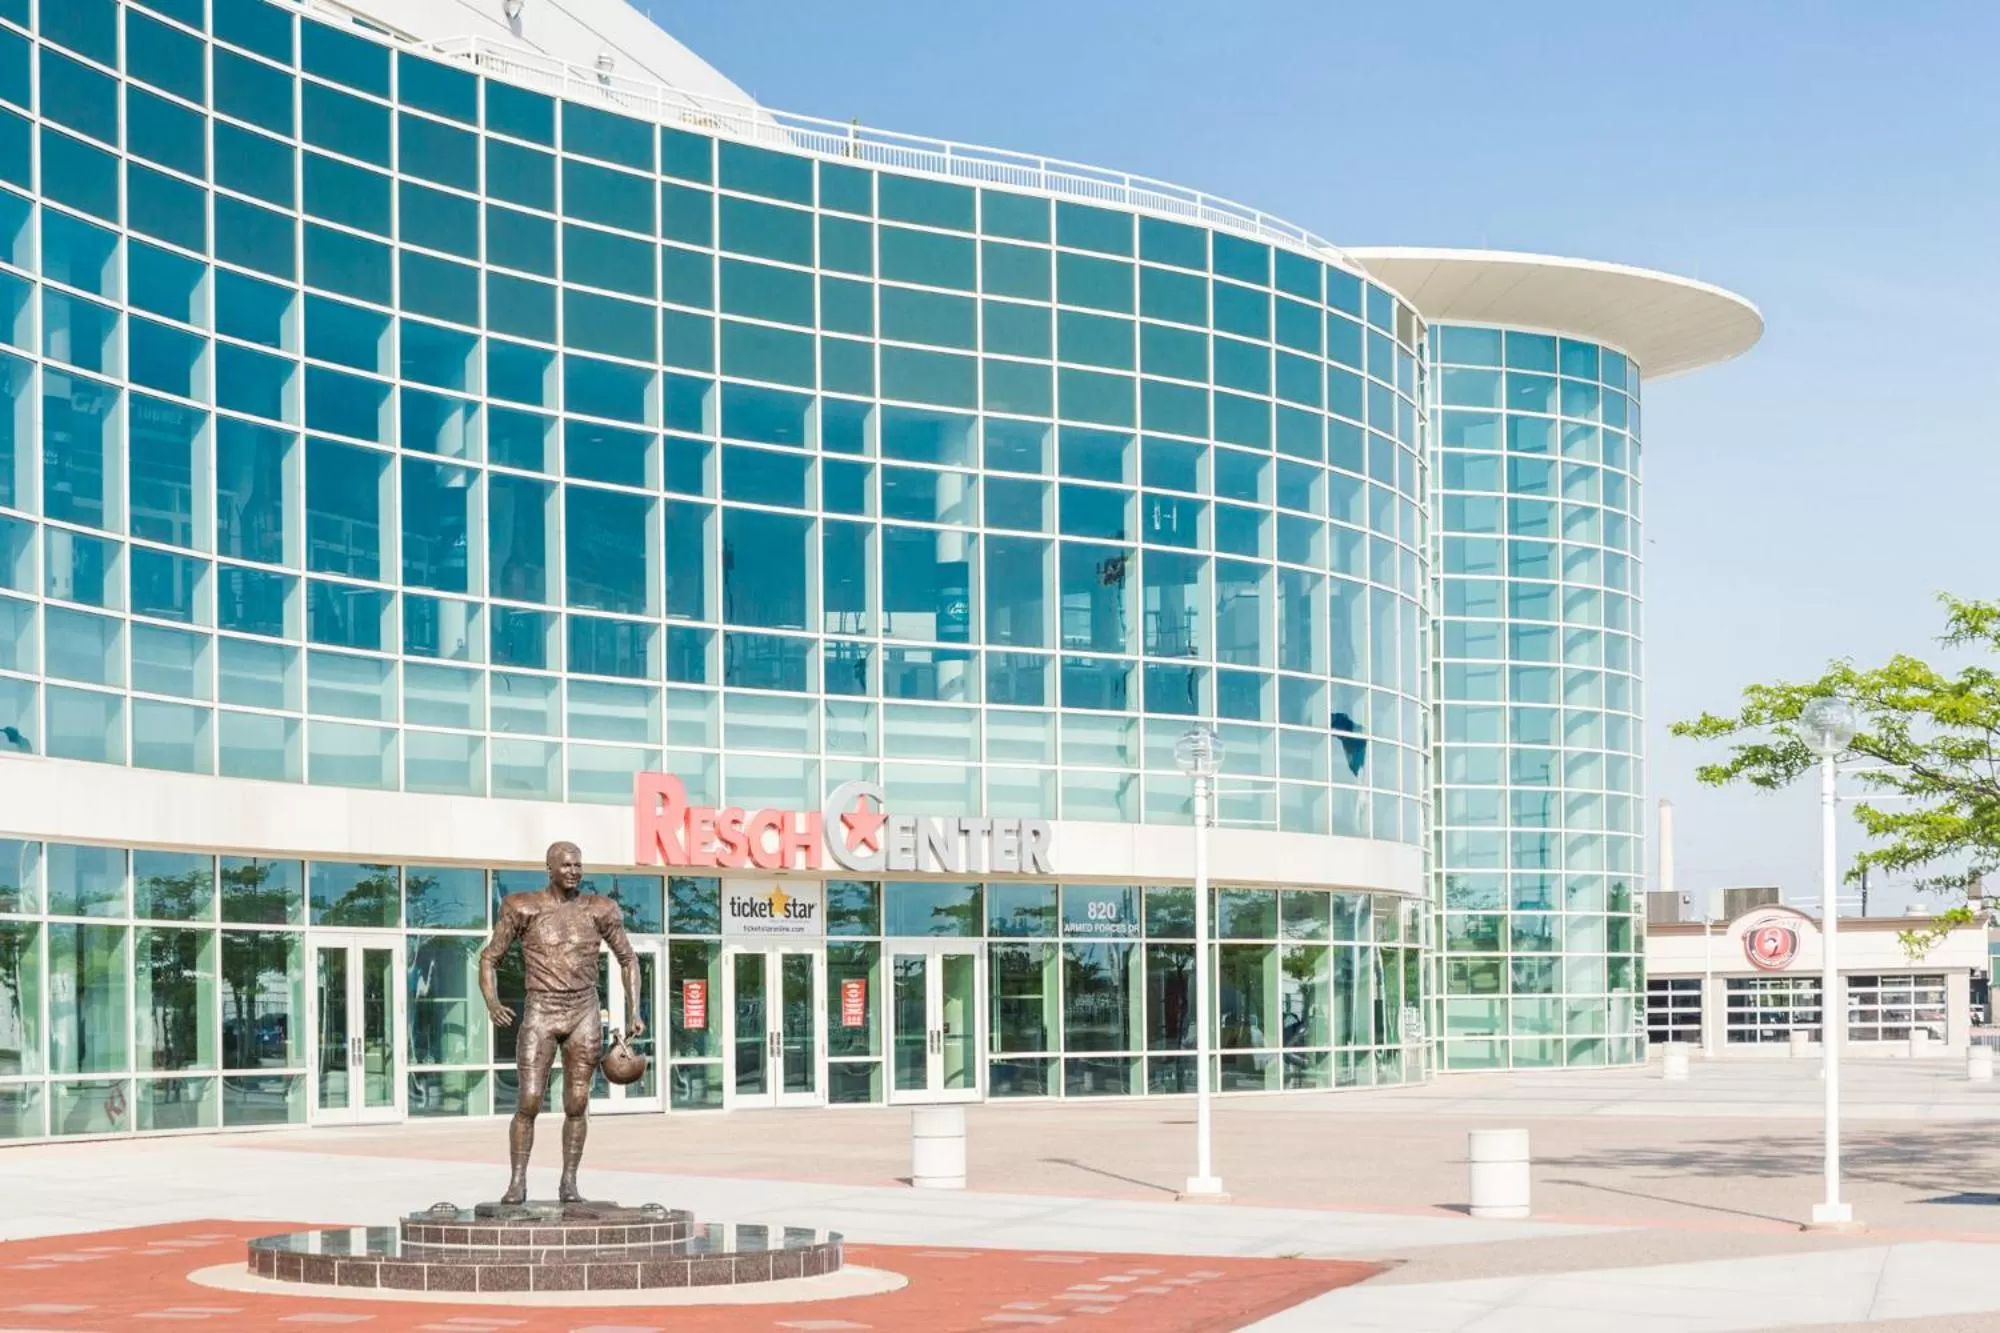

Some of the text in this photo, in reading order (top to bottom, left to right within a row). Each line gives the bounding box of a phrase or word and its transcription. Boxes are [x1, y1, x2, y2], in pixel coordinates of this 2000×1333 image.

[634, 772, 1055, 873] RESCH CENTER
[729, 896, 815, 919] ticket star
[1087, 902, 1117, 920] 820
[1064, 923, 1093, 933] ARMED
